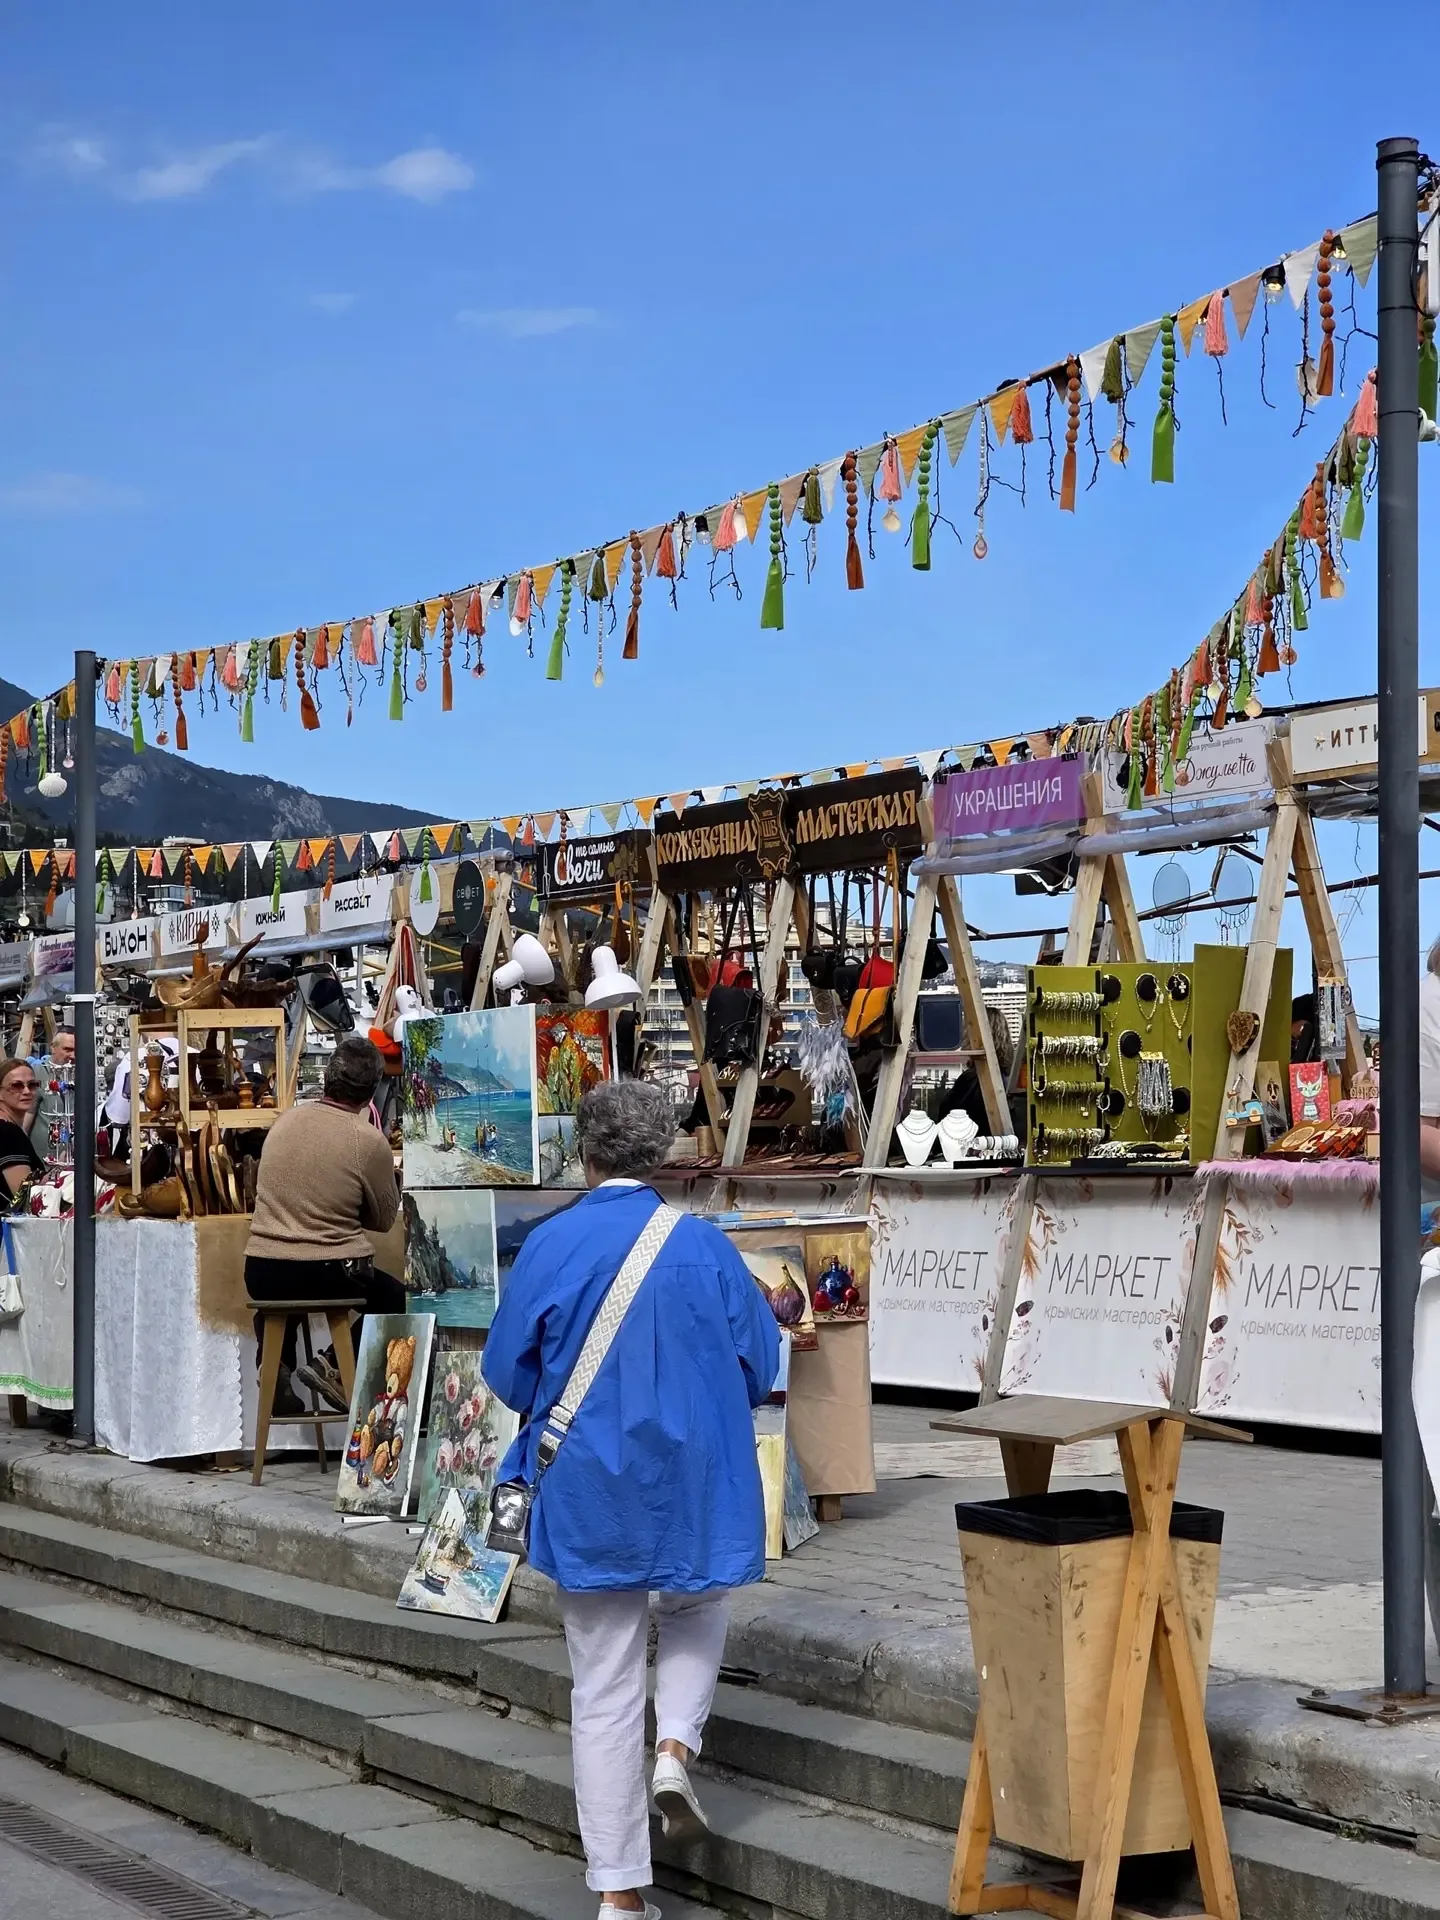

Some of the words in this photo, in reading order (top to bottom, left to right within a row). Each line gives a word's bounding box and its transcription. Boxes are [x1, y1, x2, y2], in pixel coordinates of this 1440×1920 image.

[1222, 737, 1244, 748] работы
[954, 776, 1063, 817] УКРАШЕНИЯ
[796, 789, 916, 845] МАСТЕРСКАЯ
[554, 844, 604, 886] Свечи
[575, 845, 588, 858] те
[588, 840, 616, 856] самые
[255, 906, 286, 926] ЮЖНЫЙ
[882, 1249, 988, 1291] МАРКЕТ
[1048, 1252, 1171, 1300] МАРКЕТ
[1245, 1263, 1381, 1313] МАРКЕТ
[877, 1298, 925, 1315] крымских
[929, 1300, 980, 1319] мастеров
[1043, 1305, 1099, 1323] крымских
[1102, 1308, 1161, 1329] мастеров
[1240, 1320, 1307, 1340] крымских
[1311, 1323, 1381, 1346] мастеров
